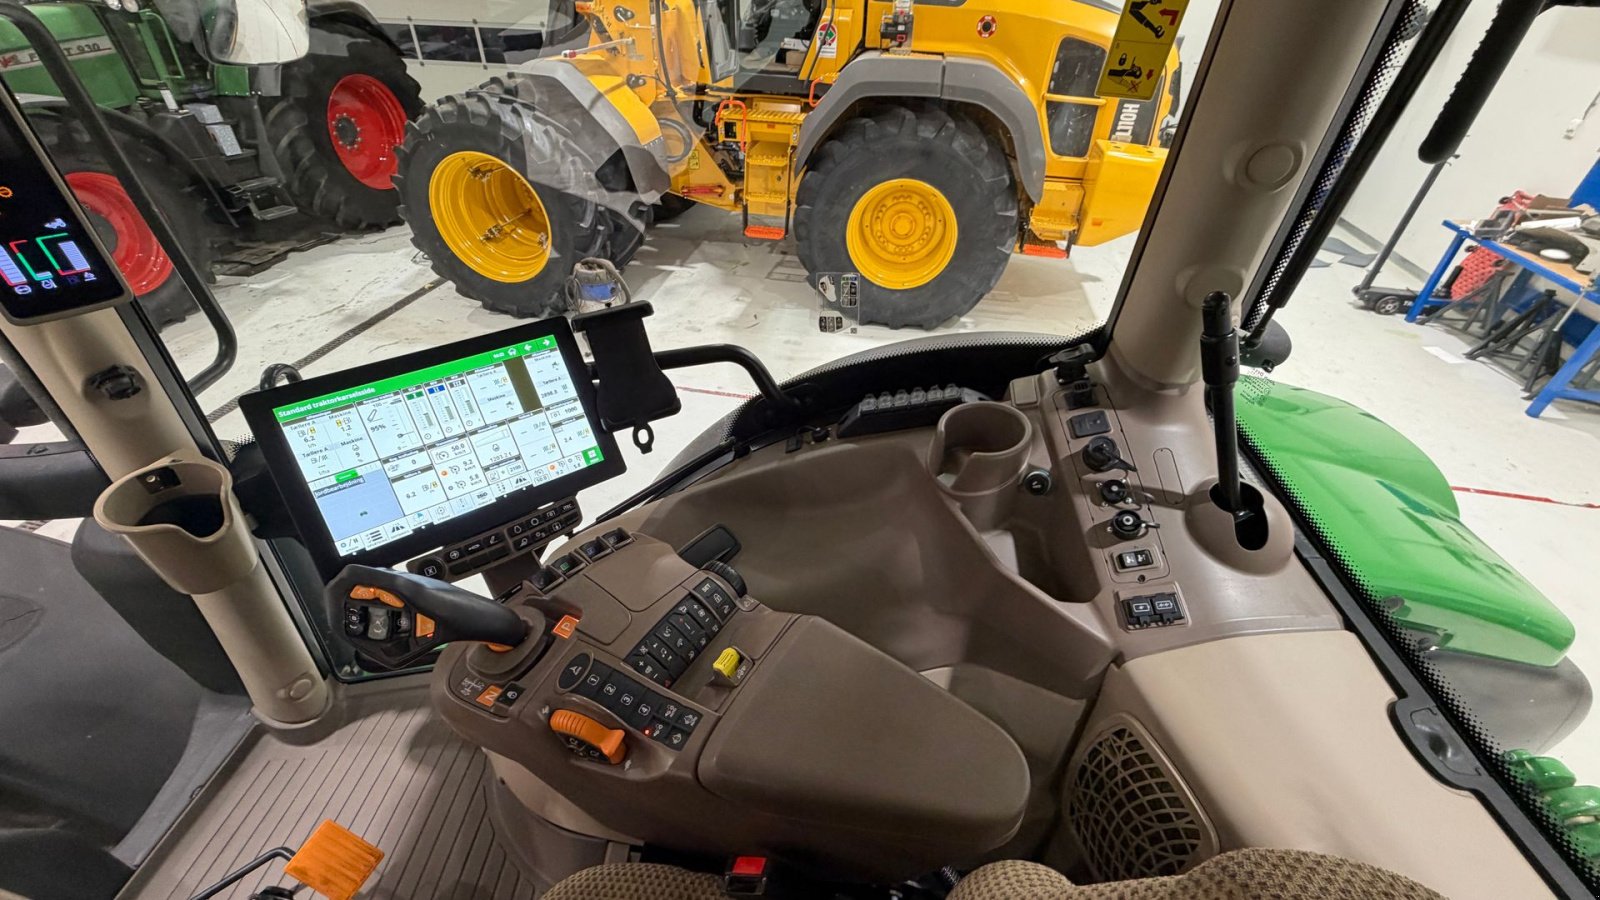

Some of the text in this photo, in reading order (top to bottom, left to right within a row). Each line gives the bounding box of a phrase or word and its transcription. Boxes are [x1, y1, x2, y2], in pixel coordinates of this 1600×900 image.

[77, 43, 100, 53] 930
[278, 405, 312, 416] Standard
[328, 410, 351, 419] Maskine
[340, 424, 352, 432] 1.2
[370, 423, 386, 432] 95%
[303, 435, 315, 443] 6.2
[340, 436, 363, 446] Maskine
[450, 442, 465, 452] 50.0
[462, 458, 473, 466] 9.2
[405, 491, 416, 499] 6.2
[561, 622, 570, 631] P
[485, 692, 498, 701] N
